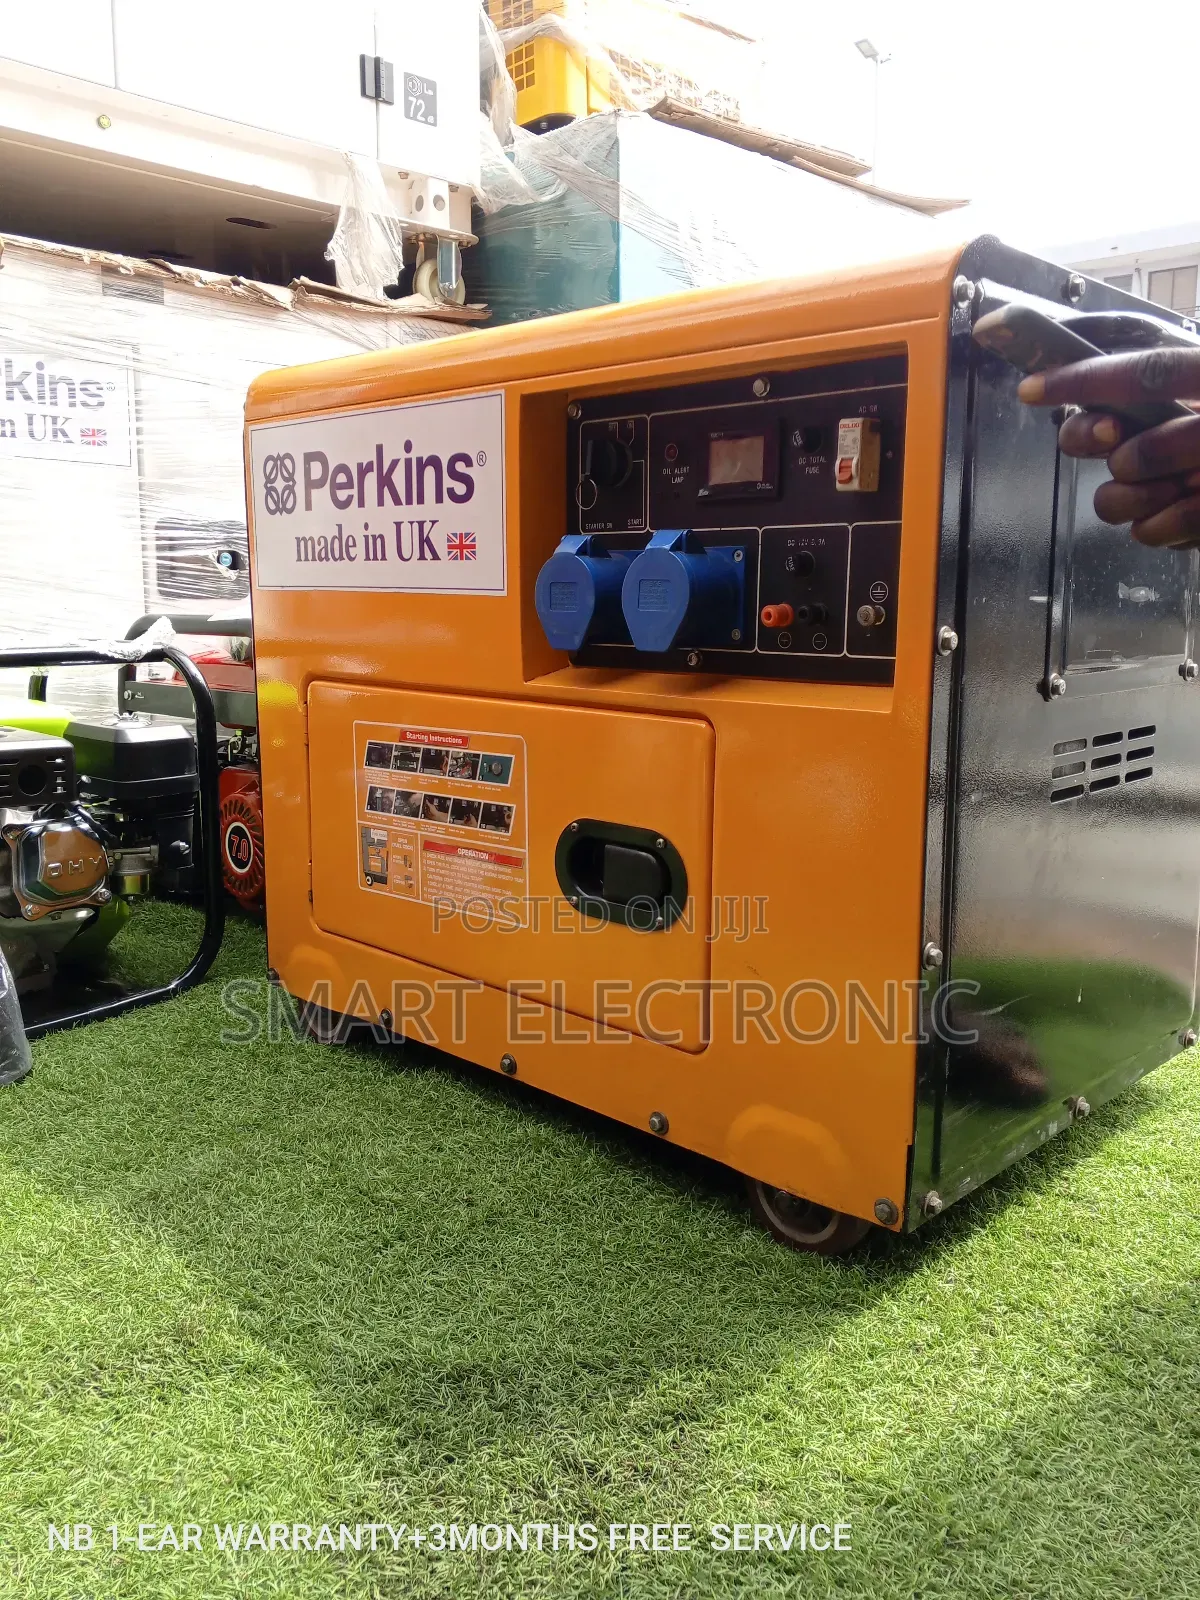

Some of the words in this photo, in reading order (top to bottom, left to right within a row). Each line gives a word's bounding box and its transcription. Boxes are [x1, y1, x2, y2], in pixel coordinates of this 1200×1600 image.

[408, 95, 426, 122] 72
[0, 357, 106, 410] kins
[0, 418, 18, 438] n
[24, 413, 75, 444] UK
[810, 455, 827, 464] TOTAL
[302, 439, 476, 512] Perkins
[675, 466, 690, 474] ALERT
[805, 466, 820, 475] FUSE
[671, 476, 685, 484] LAMP
[627, 518, 642, 526] START
[294, 524, 358, 562] made
[363, 522, 388, 562] in
[392, 519, 442, 562] UK
[406, 731, 428, 743] Starting
[429, 734, 463, 745] Instructions
[230, 835, 249, 862] 7.0
[457, 848, 489, 860] OPERATION
